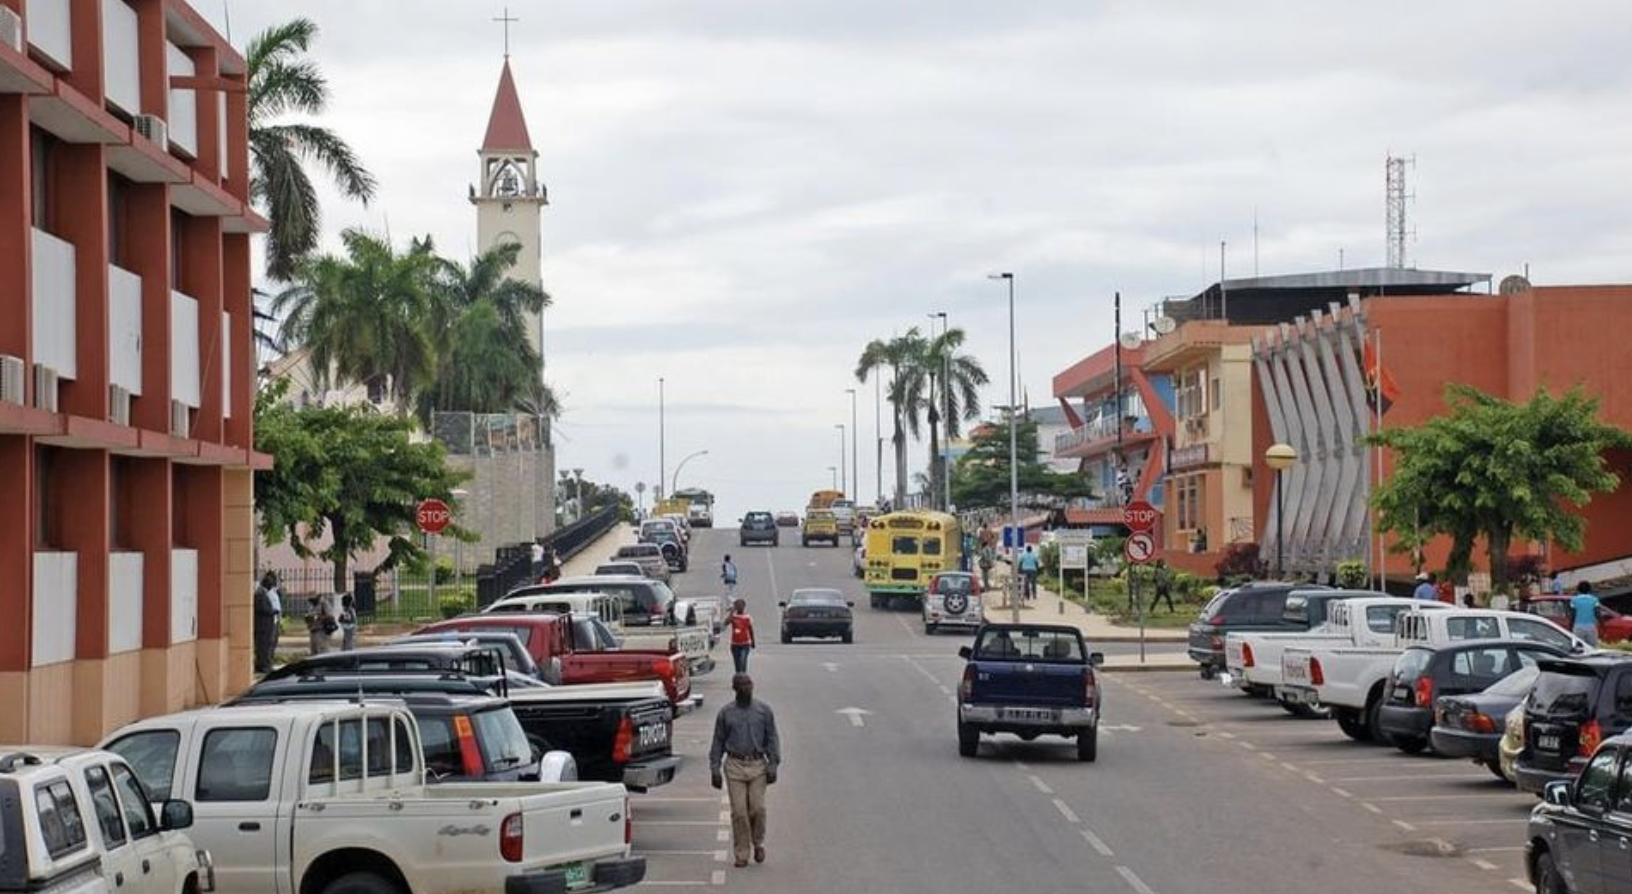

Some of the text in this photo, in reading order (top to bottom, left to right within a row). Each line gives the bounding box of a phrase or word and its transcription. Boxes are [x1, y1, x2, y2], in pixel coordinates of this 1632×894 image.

[419, 511, 449, 523] STOP
[1125, 510, 1154, 522] STOP
[680, 638, 706, 653] TOYOTA
[638, 722, 668, 748] TOYOTA
